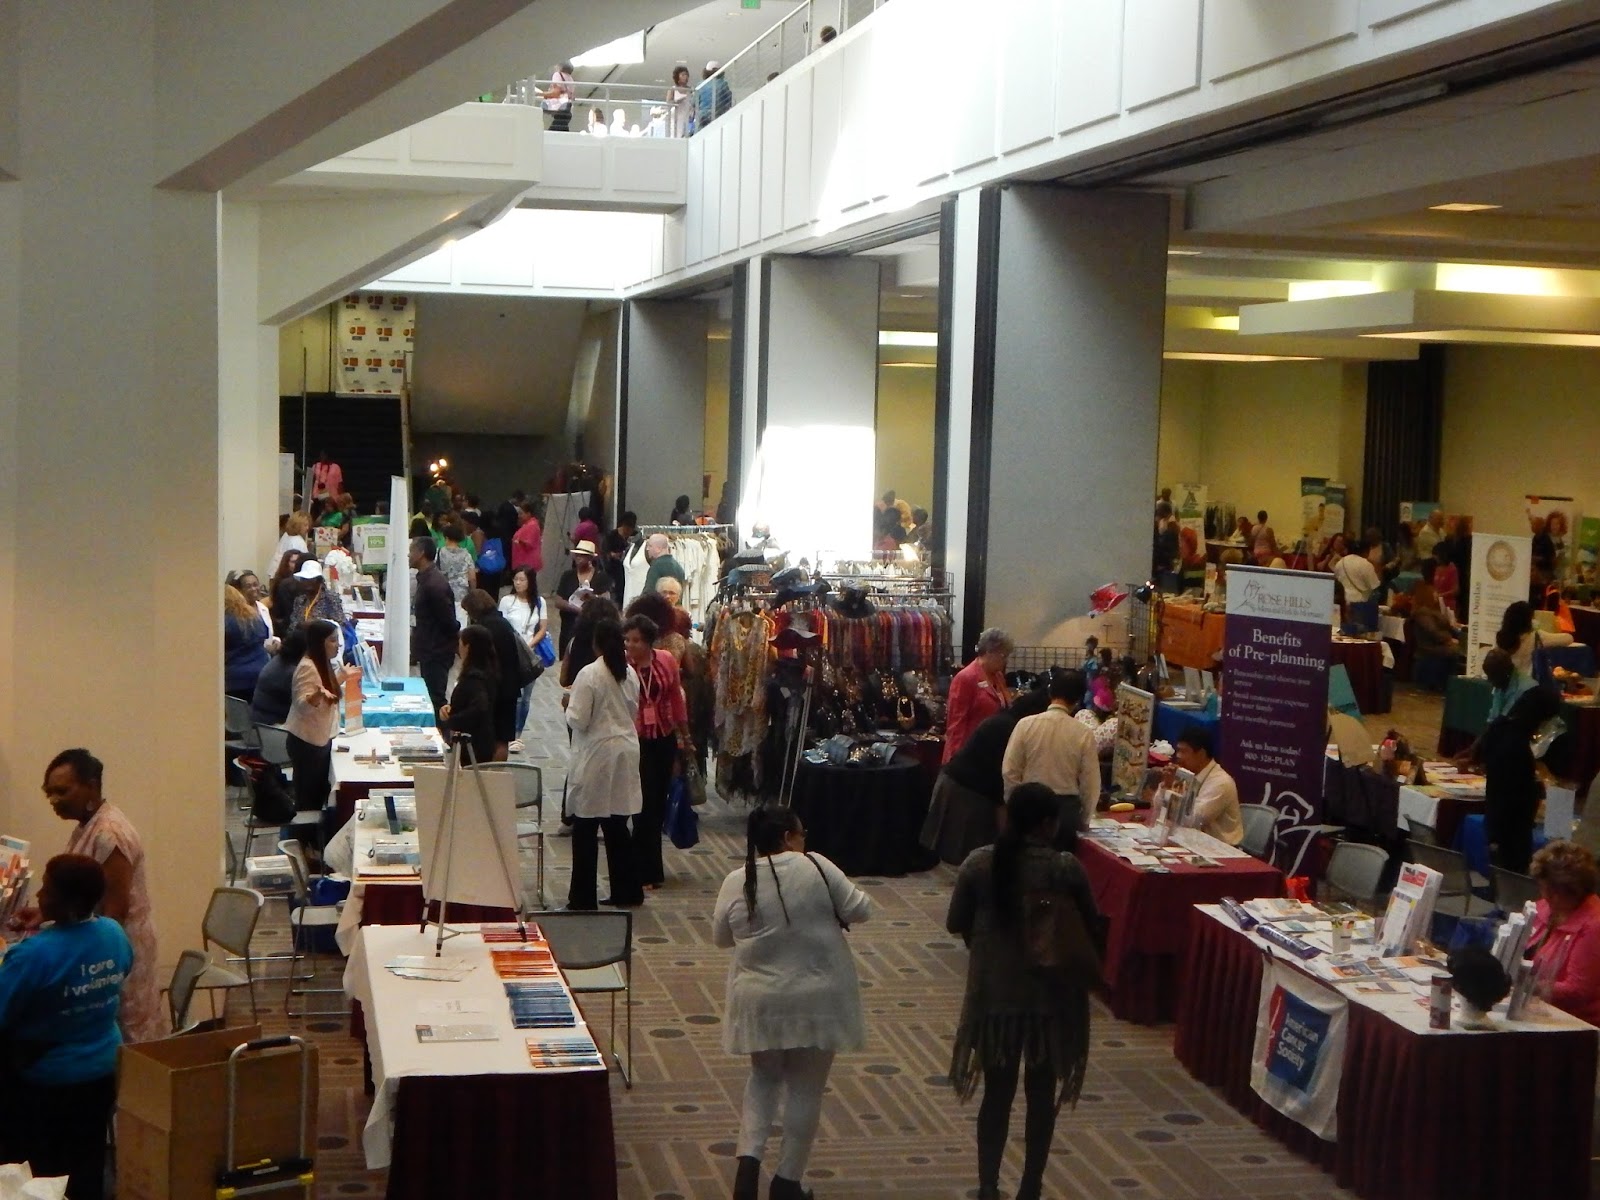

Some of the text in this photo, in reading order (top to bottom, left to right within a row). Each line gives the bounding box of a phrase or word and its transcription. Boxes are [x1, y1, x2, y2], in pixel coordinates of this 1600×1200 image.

[1252, 628, 1302, 648] Benefits
[1471, 621, 1479, 646] Birth
[1228, 644, 1325, 671] of Pre-planning
[1240, 739, 1253, 749] Ask
[1264, 742, 1279, 752] how
[88, 959, 116, 975] care
[1281, 1026, 1308, 1052] Cancer
[1277, 1040, 1306, 1072] Society
